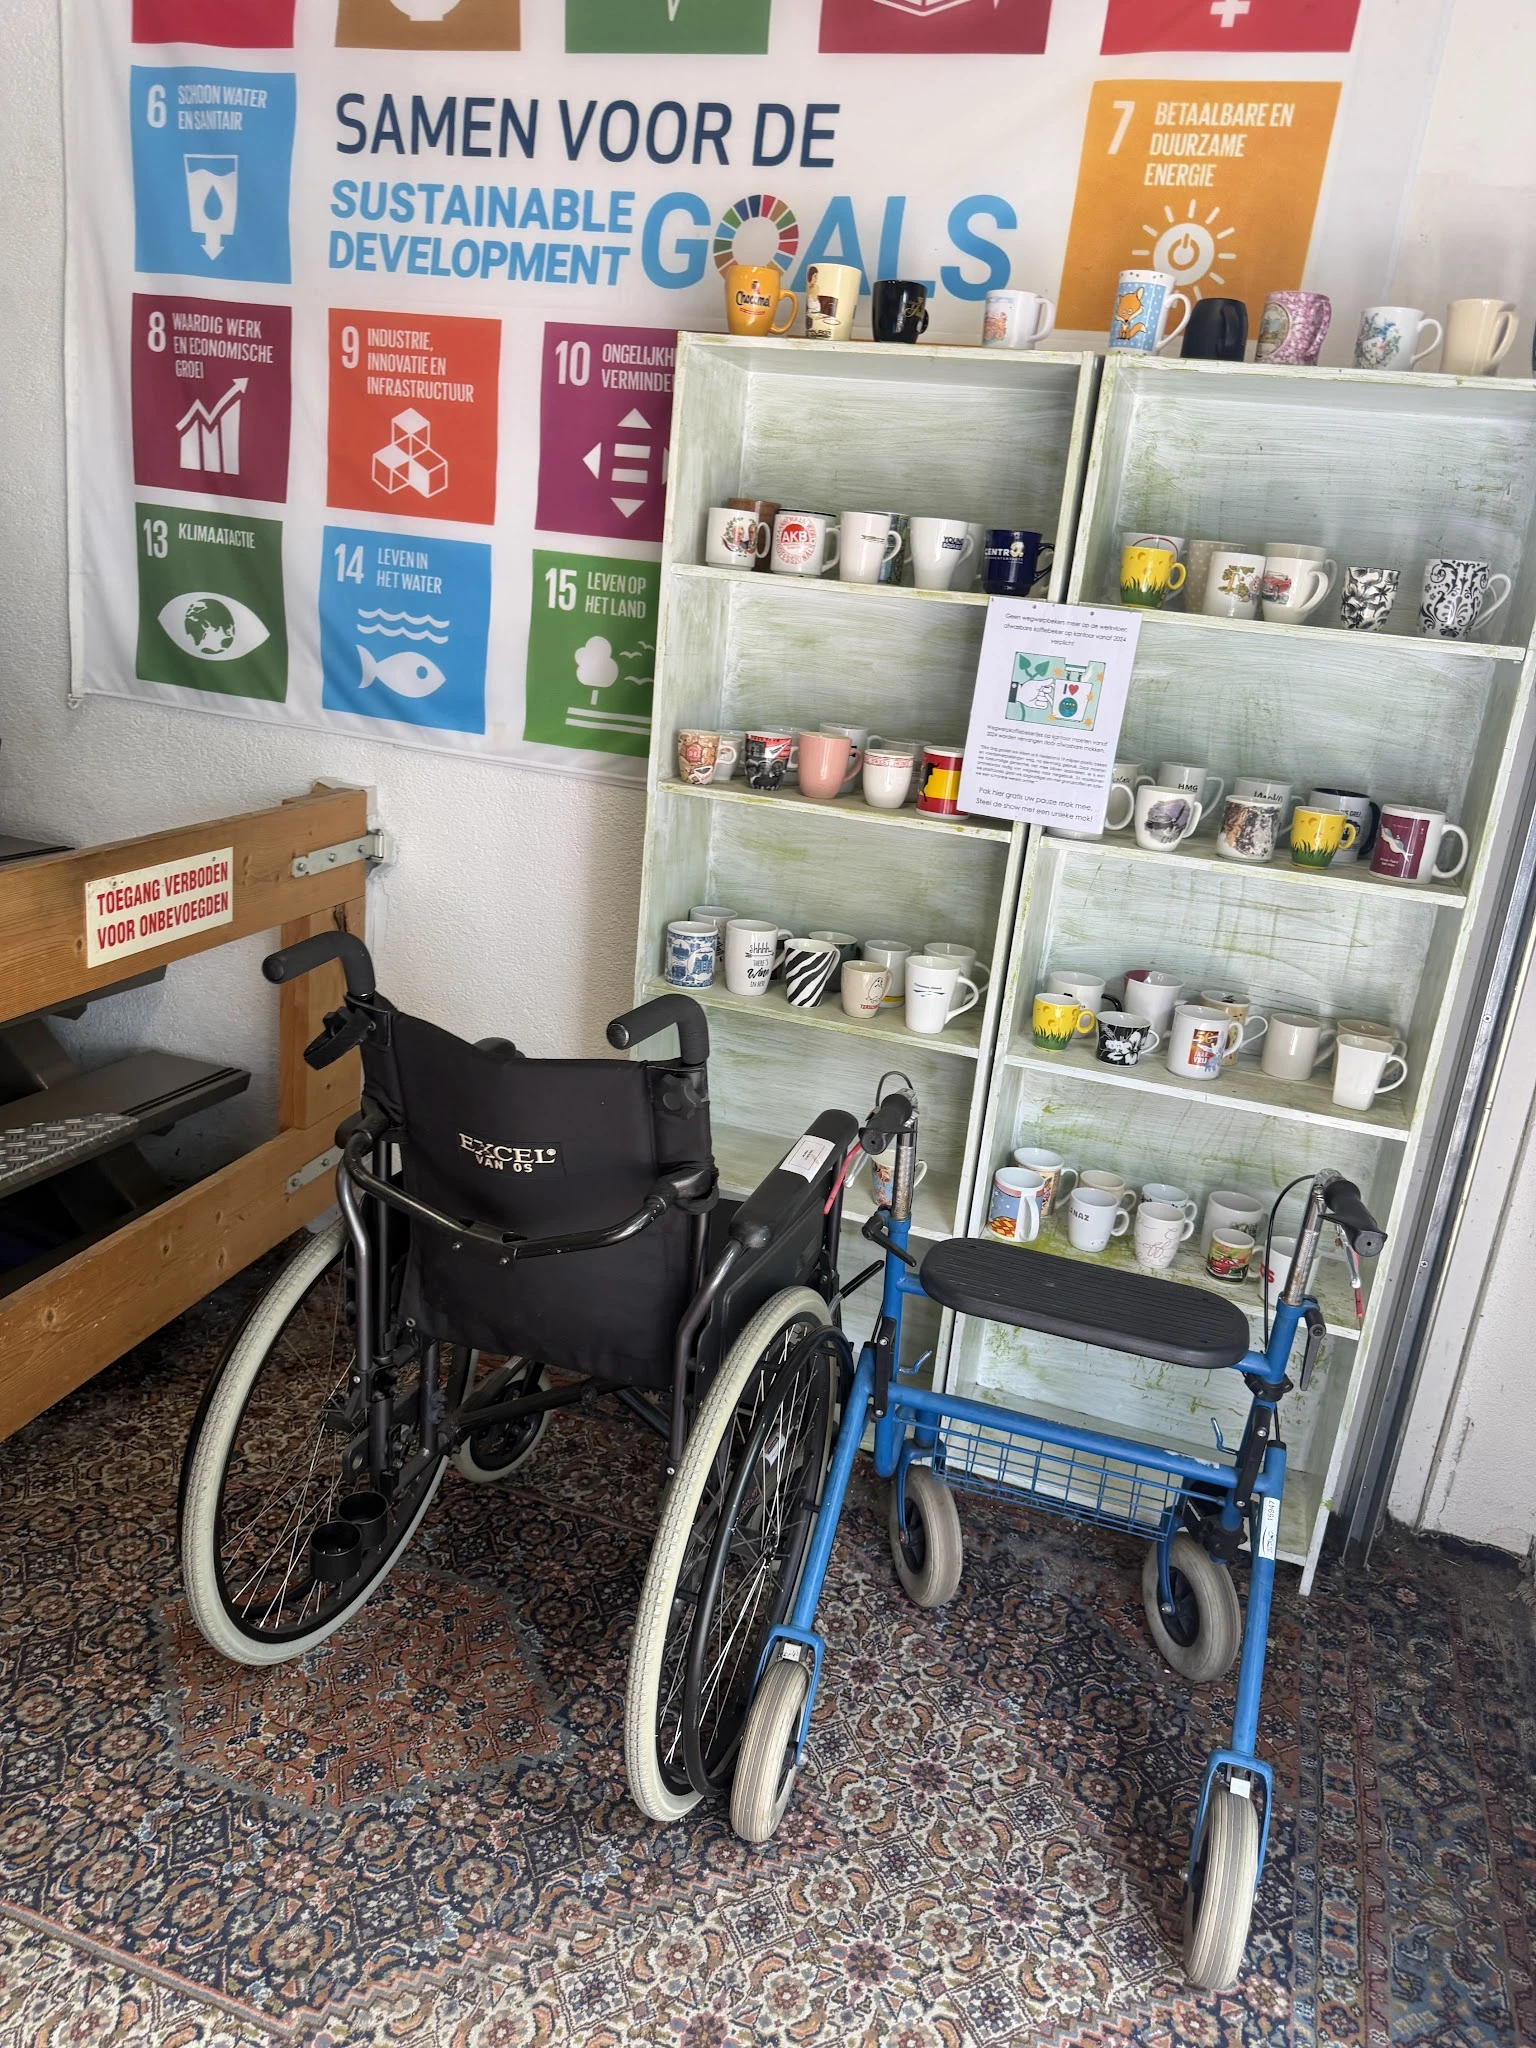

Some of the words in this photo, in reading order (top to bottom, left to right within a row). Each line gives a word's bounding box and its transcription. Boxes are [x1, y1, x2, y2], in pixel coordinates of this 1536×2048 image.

[147, 84, 167, 128] 6
[178, 84, 221, 104] SCHOON
[223, 86, 267, 108] WATER
[178, 111, 192, 130] EN
[194, 111, 243, 130] SANITAIR
[1107, 100, 1135, 155] 7
[1154, 102, 1269, 127] BETAALBARE
[1269, 103, 1295, 128] EN
[336, 92, 539, 159] SAMEN
[559, 99, 732, 166] VOOR
[752, 103, 840, 168] DE
[1149, 133, 1248, 157] DUURZAME
[1144, 163, 1217, 187] ENERGIE
[331, 179, 636, 234] SUSTAINABLE
[328, 231, 630, 286] DEVELOPMENT
[147, 311, 167, 352] 8
[172, 312, 223, 334] WAARDIG
[226, 318, 262, 339] WERK
[174, 336, 187, 354] EN
[189, 337, 273, 364] ECONOMISCHE
[341, 326, 359, 369] 9
[367, 328, 433, 352] INDUSTRIE,
[367, 352, 430, 374] INNOVATIE
[431, 357, 446, 376] EN
[555, 340, 591, 387] 10
[602, 343, 675, 367] ONGELIJKH
[175, 359, 204, 379] GROEI
[602, 369, 675, 392] VERMINDE
[367, 376, 474, 403] INFRASTRUCTUUR
[143, 518, 168, 559] 13
[178, 522, 255, 549] KLIMAATACTIE
[781, 530, 808, 543] AKB
[334, 543, 364, 584] 14
[378, 547, 413, 568] LEVEN
[415, 552, 428, 570] IN
[376, 571, 400, 589] HET
[401, 573, 442, 594] WATER
[545, 567, 577, 611] 15
[587, 571, 625, 593] LEVEN
[628, 576, 646, 595] OP
[585, 595, 609, 615] HET
[610, 598, 646, 619] LAND
[978, 786, 991, 795] Pak
[992, 788, 1004, 797] hier
[1005, 790, 1023, 800] gratis
[1024, 793, 1034, 802] uw
[1035, 795, 1057, 806] pauze
[1058, 799, 1073, 808] mok
[1177, 783, 1198, 792] HMG
[975, 797, 991, 806] Steel
[992, 800, 1002, 808] de
[1003, 801, 1020, 811] show
[1021, 804, 1035, 813] met
[1036, 807, 1050, 815] een
[1050, 809, 1074, 819] unieke
[97, 879, 160, 916] TOEGANG
[164, 861, 228, 897] VERBODEN
[97, 919, 135, 950] VOOR
[139, 891, 229, 937] ONBEVOEGDEN
[475, 1155, 504, 1170] VAN
[513, 1163, 533, 1173] OS
